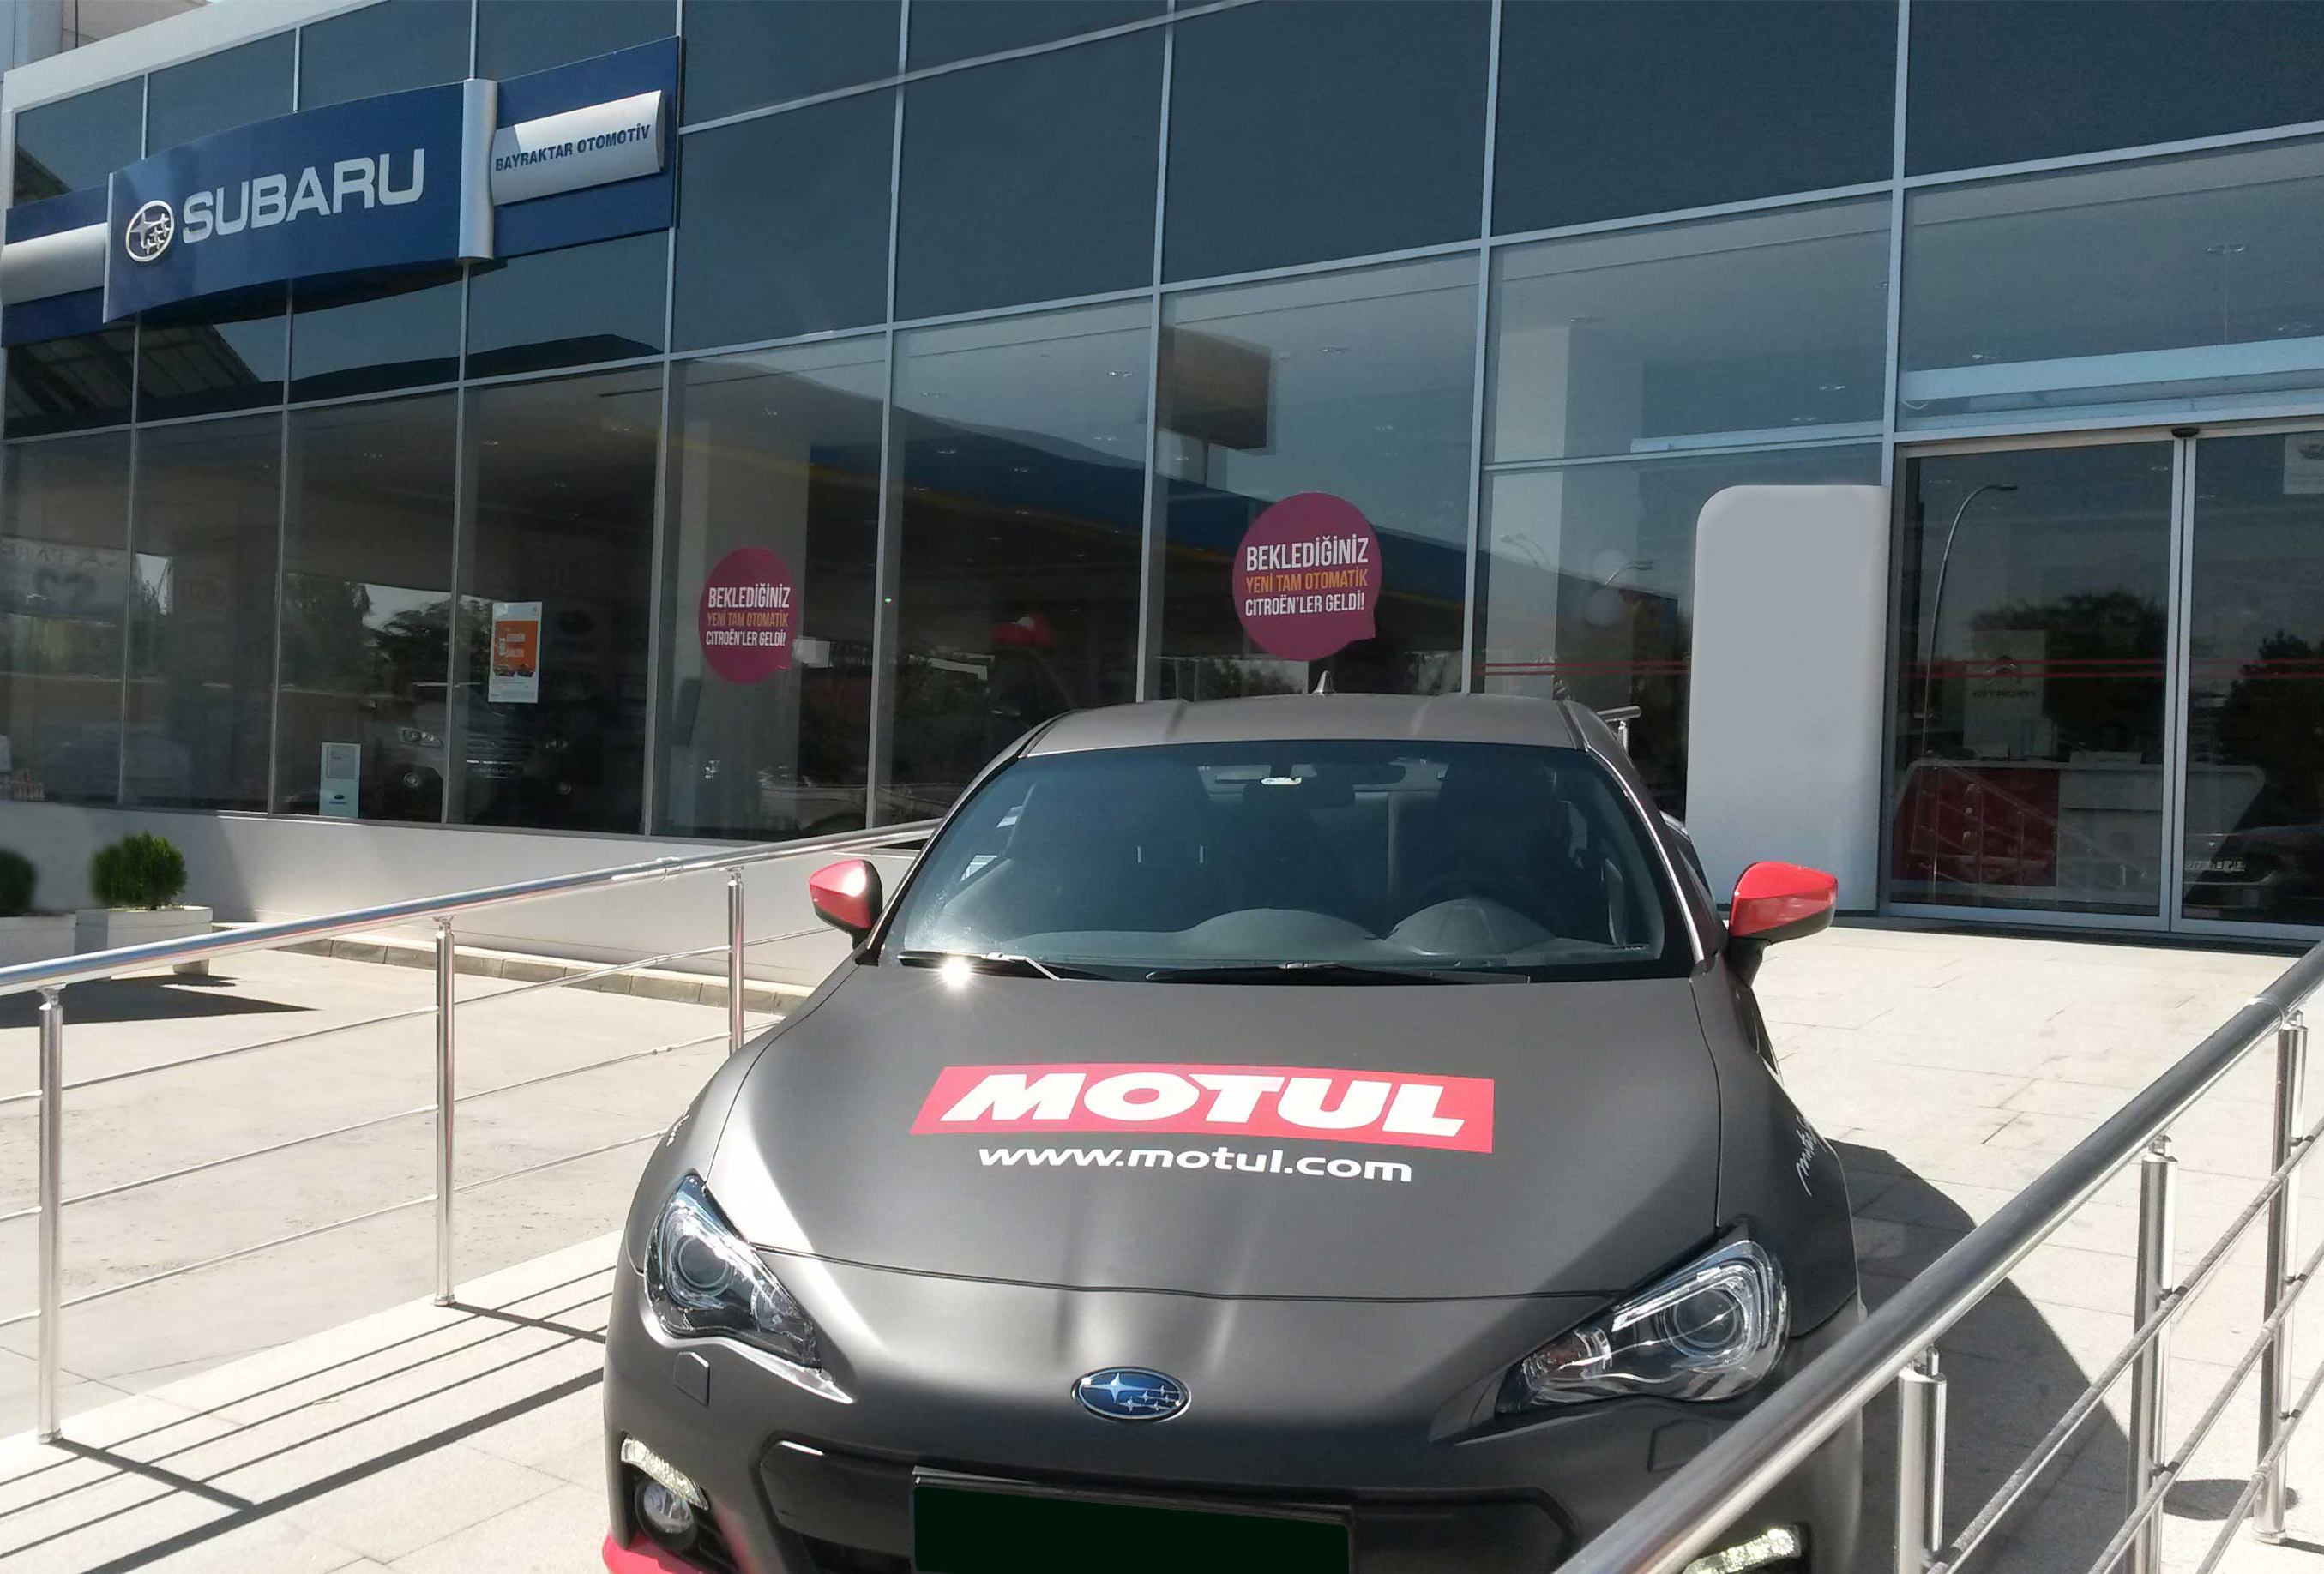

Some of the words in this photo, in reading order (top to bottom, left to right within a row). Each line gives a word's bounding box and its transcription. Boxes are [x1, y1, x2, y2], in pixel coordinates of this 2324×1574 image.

[495, 142, 573, 171] BAYRAKTAR
[577, 123, 651, 153] OTOMOTİV
[182, 148, 425, 244] SUBARU
[1246, 534, 1369, 571] BEKLEDİĞİNİZ
[708, 583, 791, 609] BEKLEDİĞİNİZ
[1246, 573, 1273, 594] YENİ
[1276, 574, 1303, 592] TAM
[1305, 567, 1368, 589] OTOMATİK
[707, 610, 726, 627] YENİ
[728, 611, 744, 627] TAM
[746, 610, 789, 627] OTOMATİK
[1245, 594, 1322, 616] CITROËN'LER
[1325, 590, 1365, 612] GELDİ!
[706, 628, 757, 646] CITROËN'LER
[759, 628, 786, 646] GELDİ!
[939, 1072, 1466, 1138] MOTUL
[978, 1146, 1412, 1182] www.motul.com
